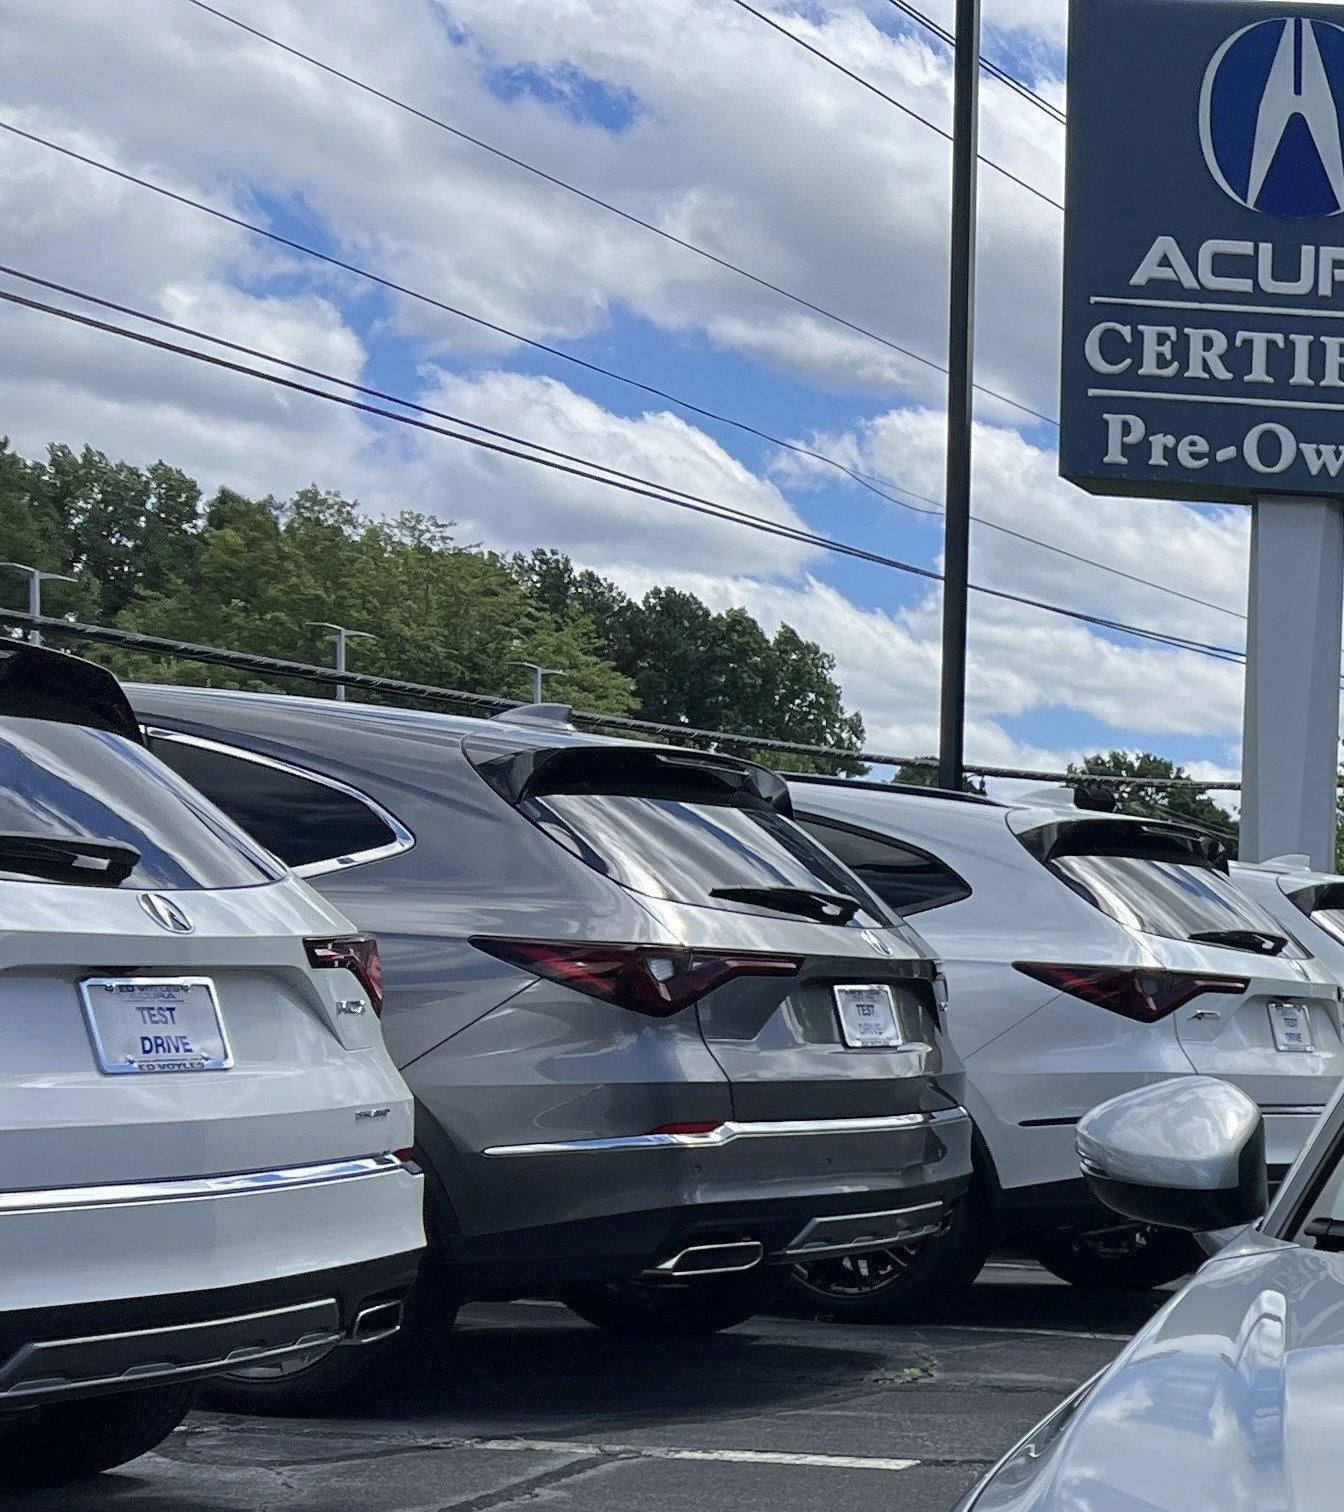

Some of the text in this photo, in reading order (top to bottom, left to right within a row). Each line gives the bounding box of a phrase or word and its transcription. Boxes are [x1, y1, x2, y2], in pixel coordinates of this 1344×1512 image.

[135, 1007, 177, 1025] TEST
[856, 1004, 875, 1016] TEST
[140, 1036, 193, 1054] DRIVE
